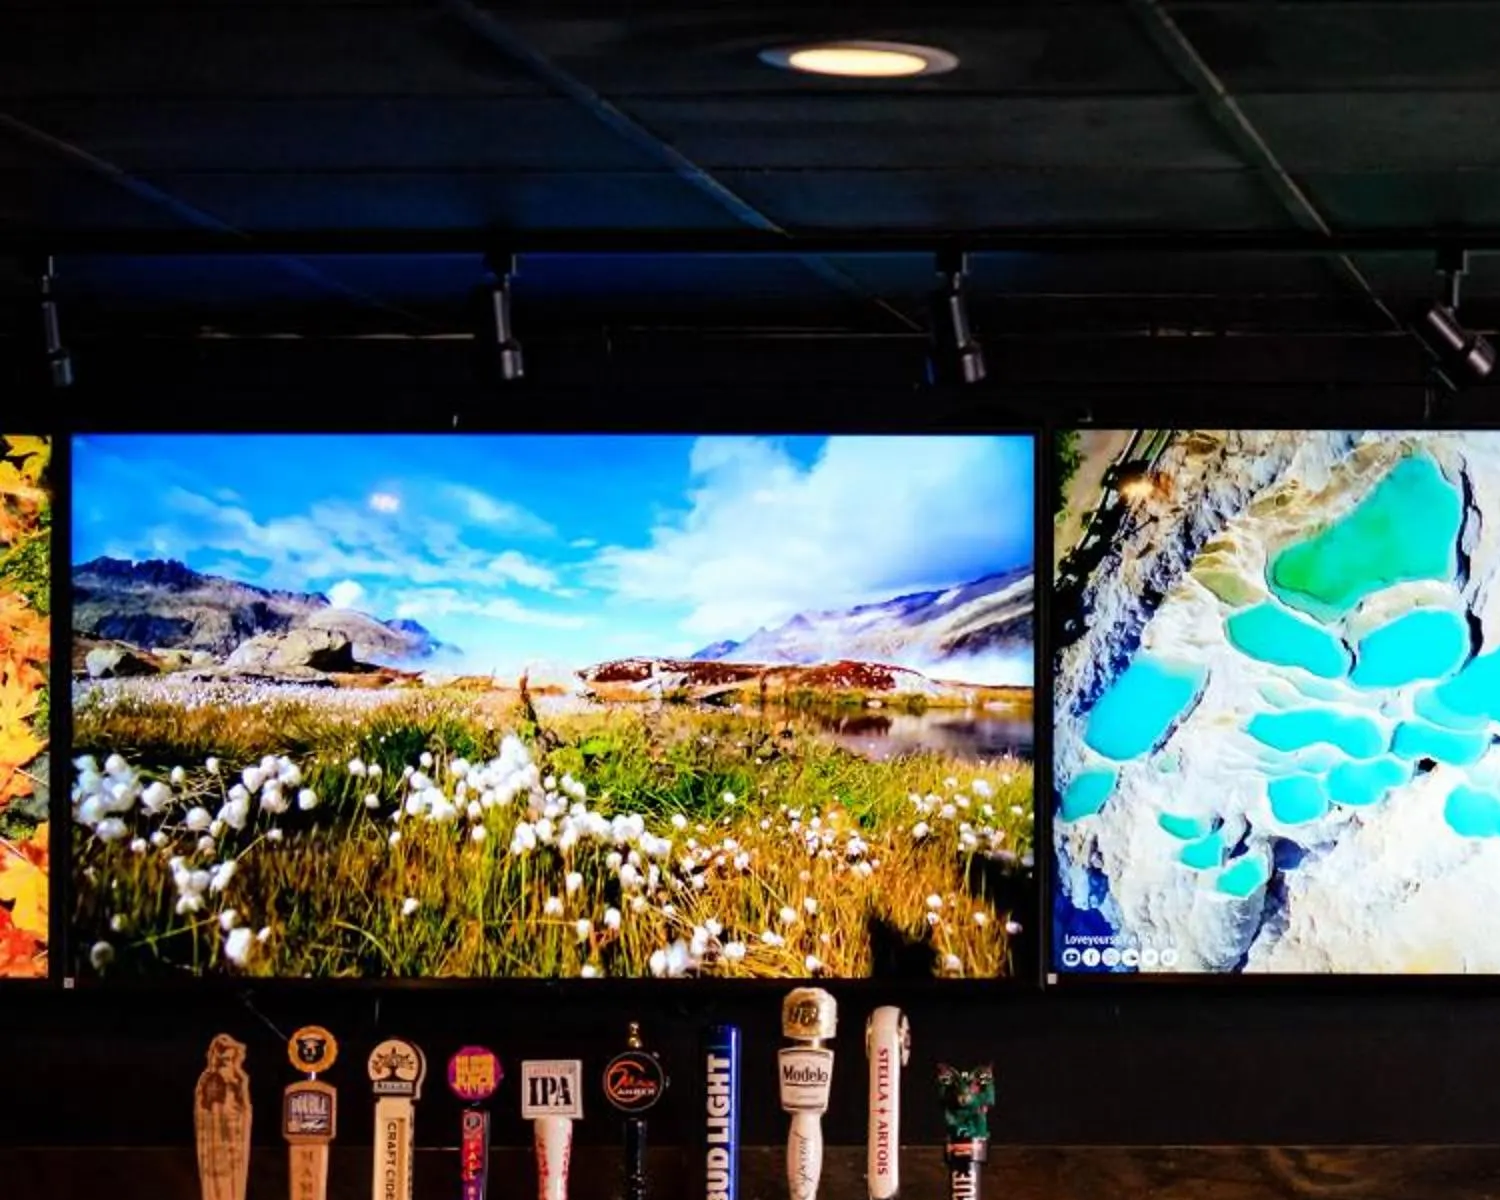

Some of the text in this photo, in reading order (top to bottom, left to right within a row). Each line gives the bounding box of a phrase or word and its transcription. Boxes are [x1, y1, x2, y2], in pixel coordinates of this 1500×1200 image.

[528, 1076, 573, 1107] IPA
[782, 1064, 828, 1083] Modelo
[706, 1053, 730, 1143] LIGHT
[877, 1047, 889, 1175] STELLA ARTOIS
[386, 1121, 397, 1166] CRAFT
